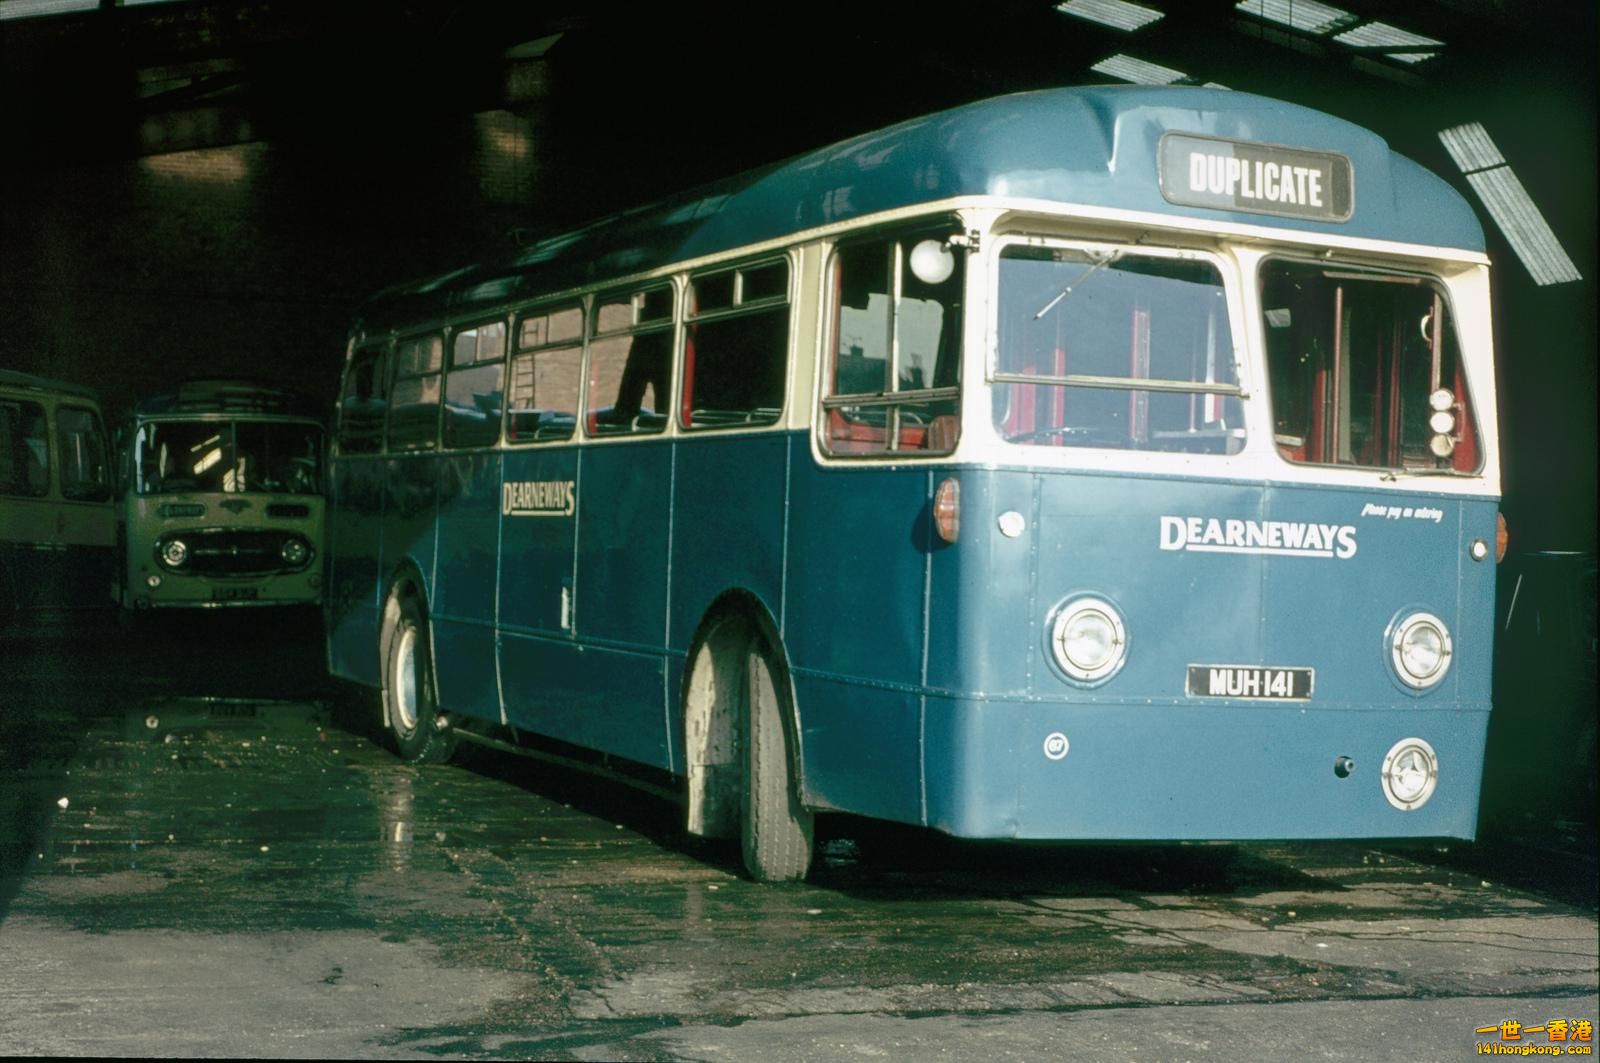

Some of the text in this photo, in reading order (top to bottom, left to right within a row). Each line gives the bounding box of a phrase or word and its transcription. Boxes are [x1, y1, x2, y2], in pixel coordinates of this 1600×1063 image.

[1189, 152, 1323, 208] DUPLICATE
[502, 480, 575, 517] DEARNEWAYS
[1159, 515, 1358, 560] DEARNEWAYS
[1208, 668, 1294, 697] MUH 141
